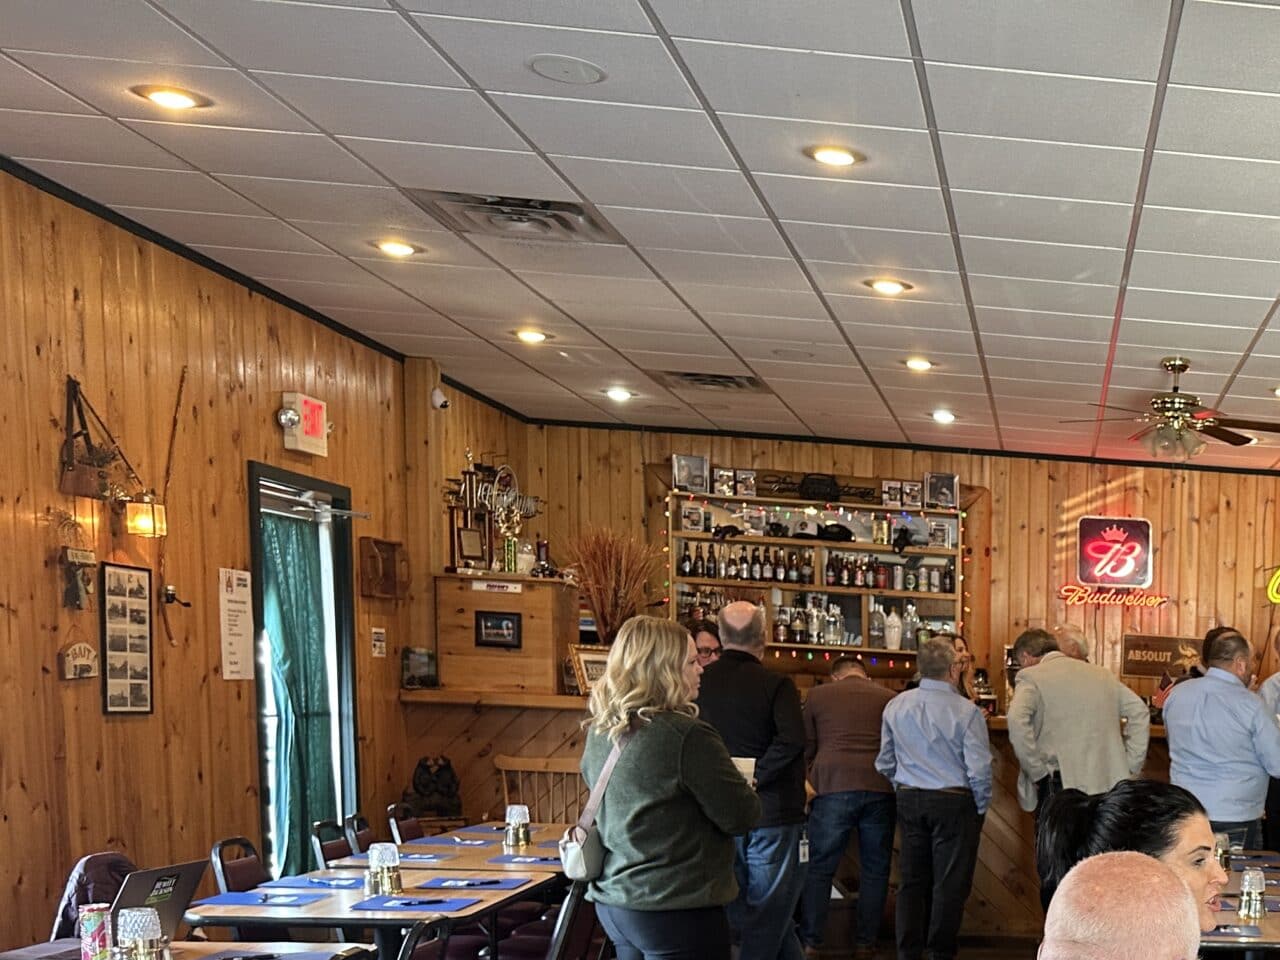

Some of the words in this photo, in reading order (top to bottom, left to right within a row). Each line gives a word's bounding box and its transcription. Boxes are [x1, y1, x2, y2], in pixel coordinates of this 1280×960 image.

[1060, 585, 1168, 609] Budweiser
[71, 646, 92, 661] BAIT
[1127, 649, 1172, 662] ABSOLUT
